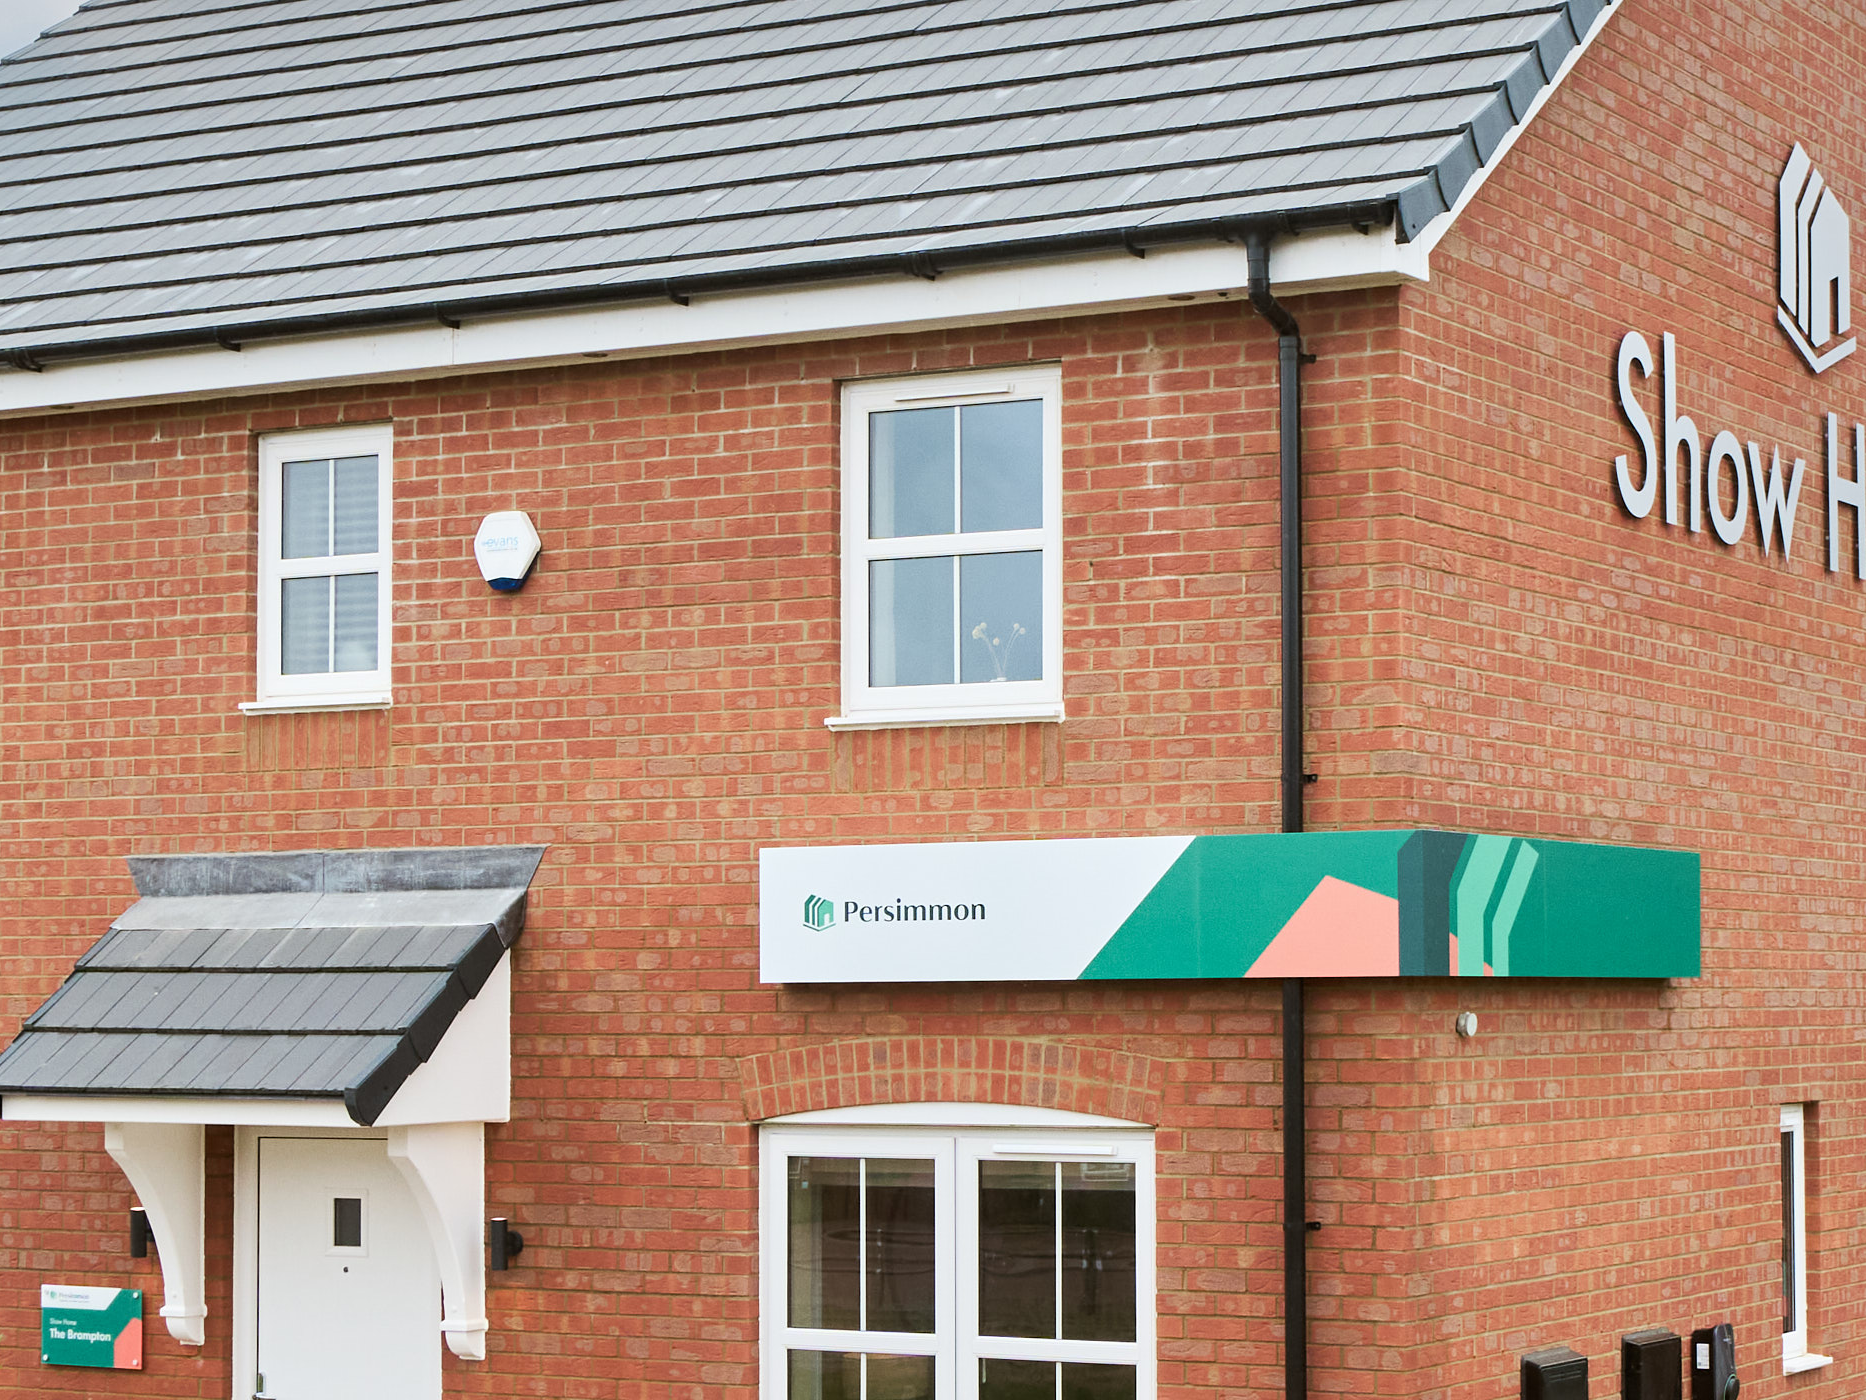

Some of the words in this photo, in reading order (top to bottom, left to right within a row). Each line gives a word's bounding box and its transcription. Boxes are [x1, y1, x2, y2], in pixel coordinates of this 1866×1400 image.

[1615, 331, 1806, 563] Show
[844, 898, 986, 922] Persimmon
[49, 1327, 66, 1339] The
[67, 1329, 112, 1344] Brampton
